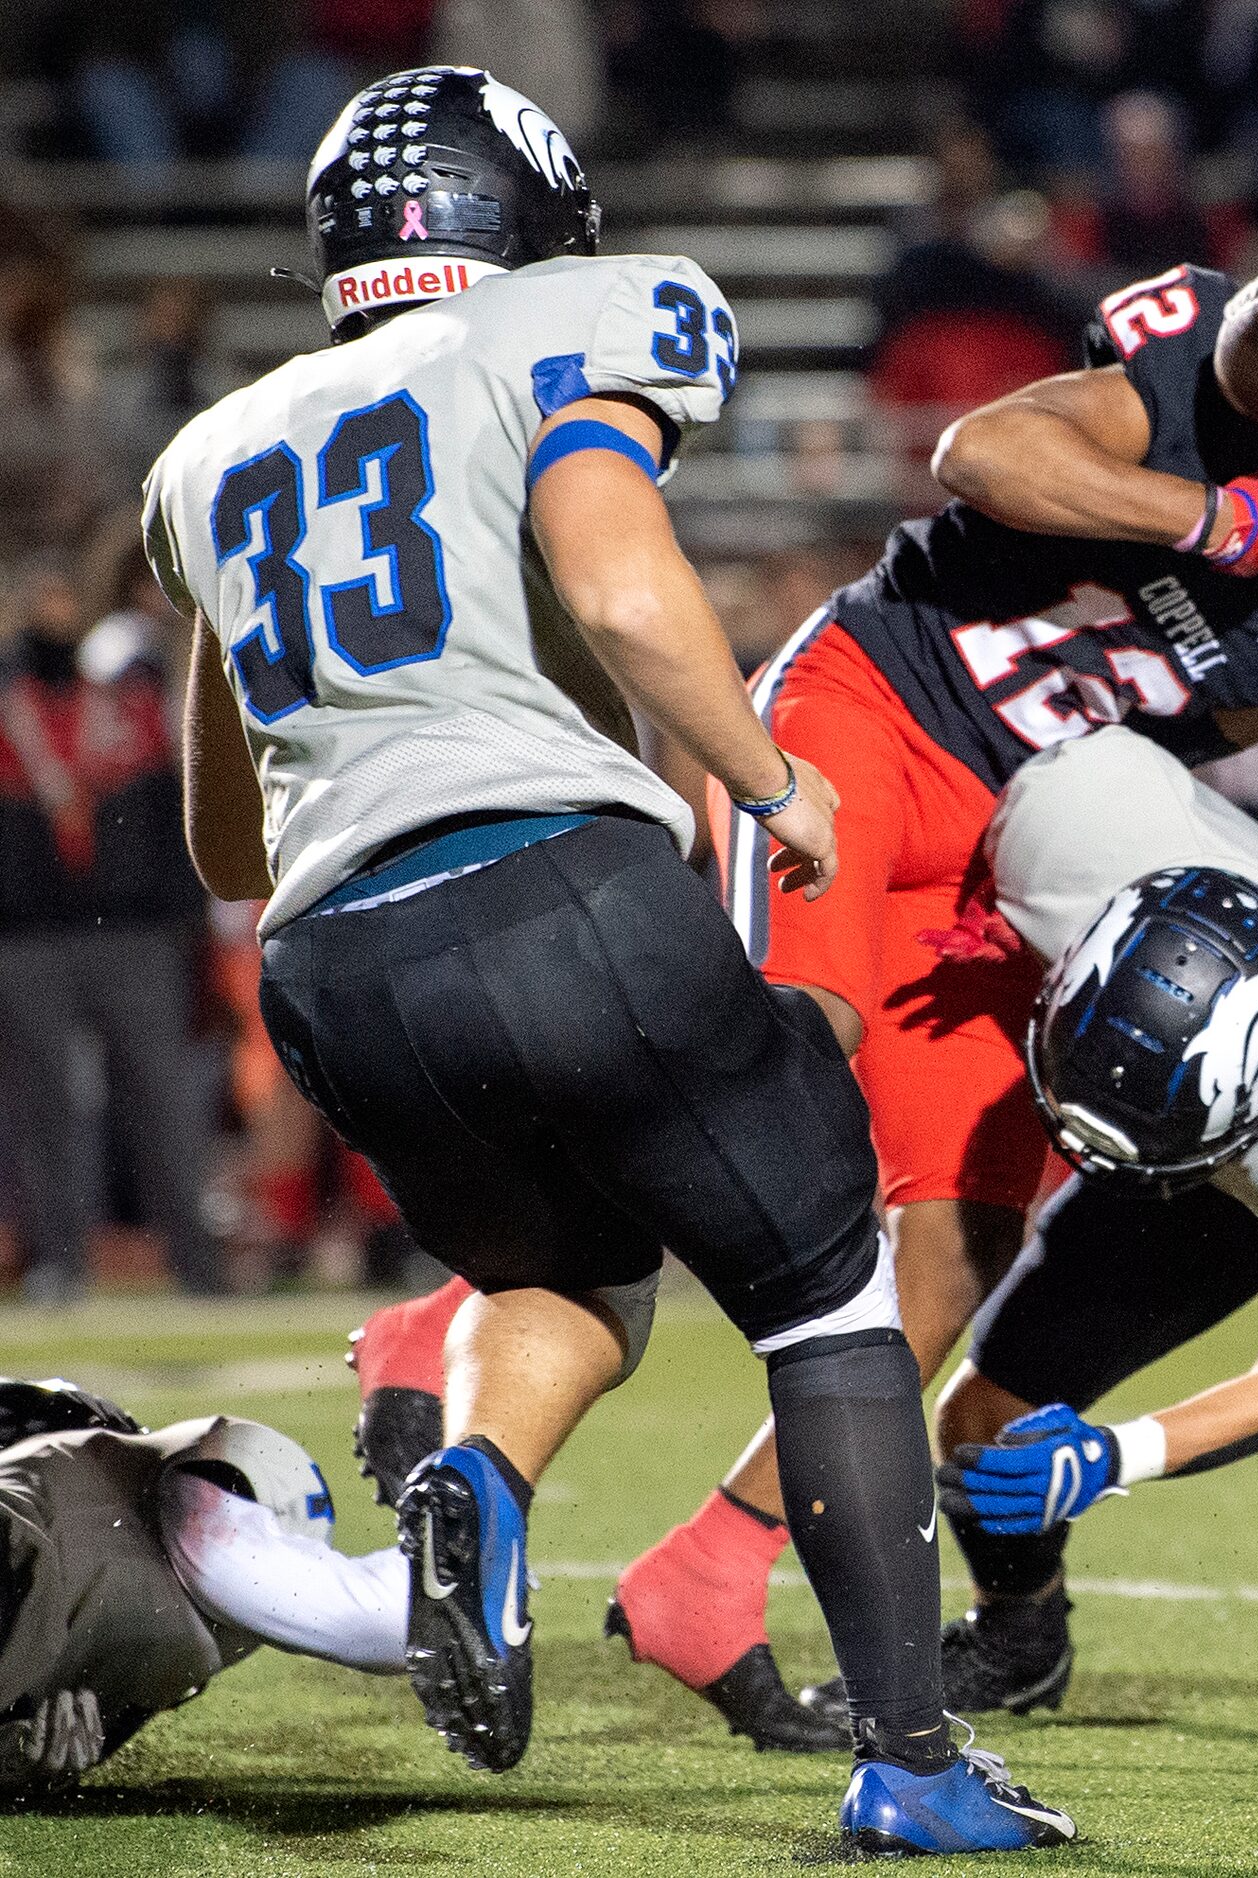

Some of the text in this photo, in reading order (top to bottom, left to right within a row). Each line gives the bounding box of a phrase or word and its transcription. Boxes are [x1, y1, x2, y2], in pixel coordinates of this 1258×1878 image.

[338, 265, 470, 308] Riddell
[1099, 264, 1200, 361] 12
[209, 388, 453, 726] 33
[1138, 575, 1228, 681] COPPELL
